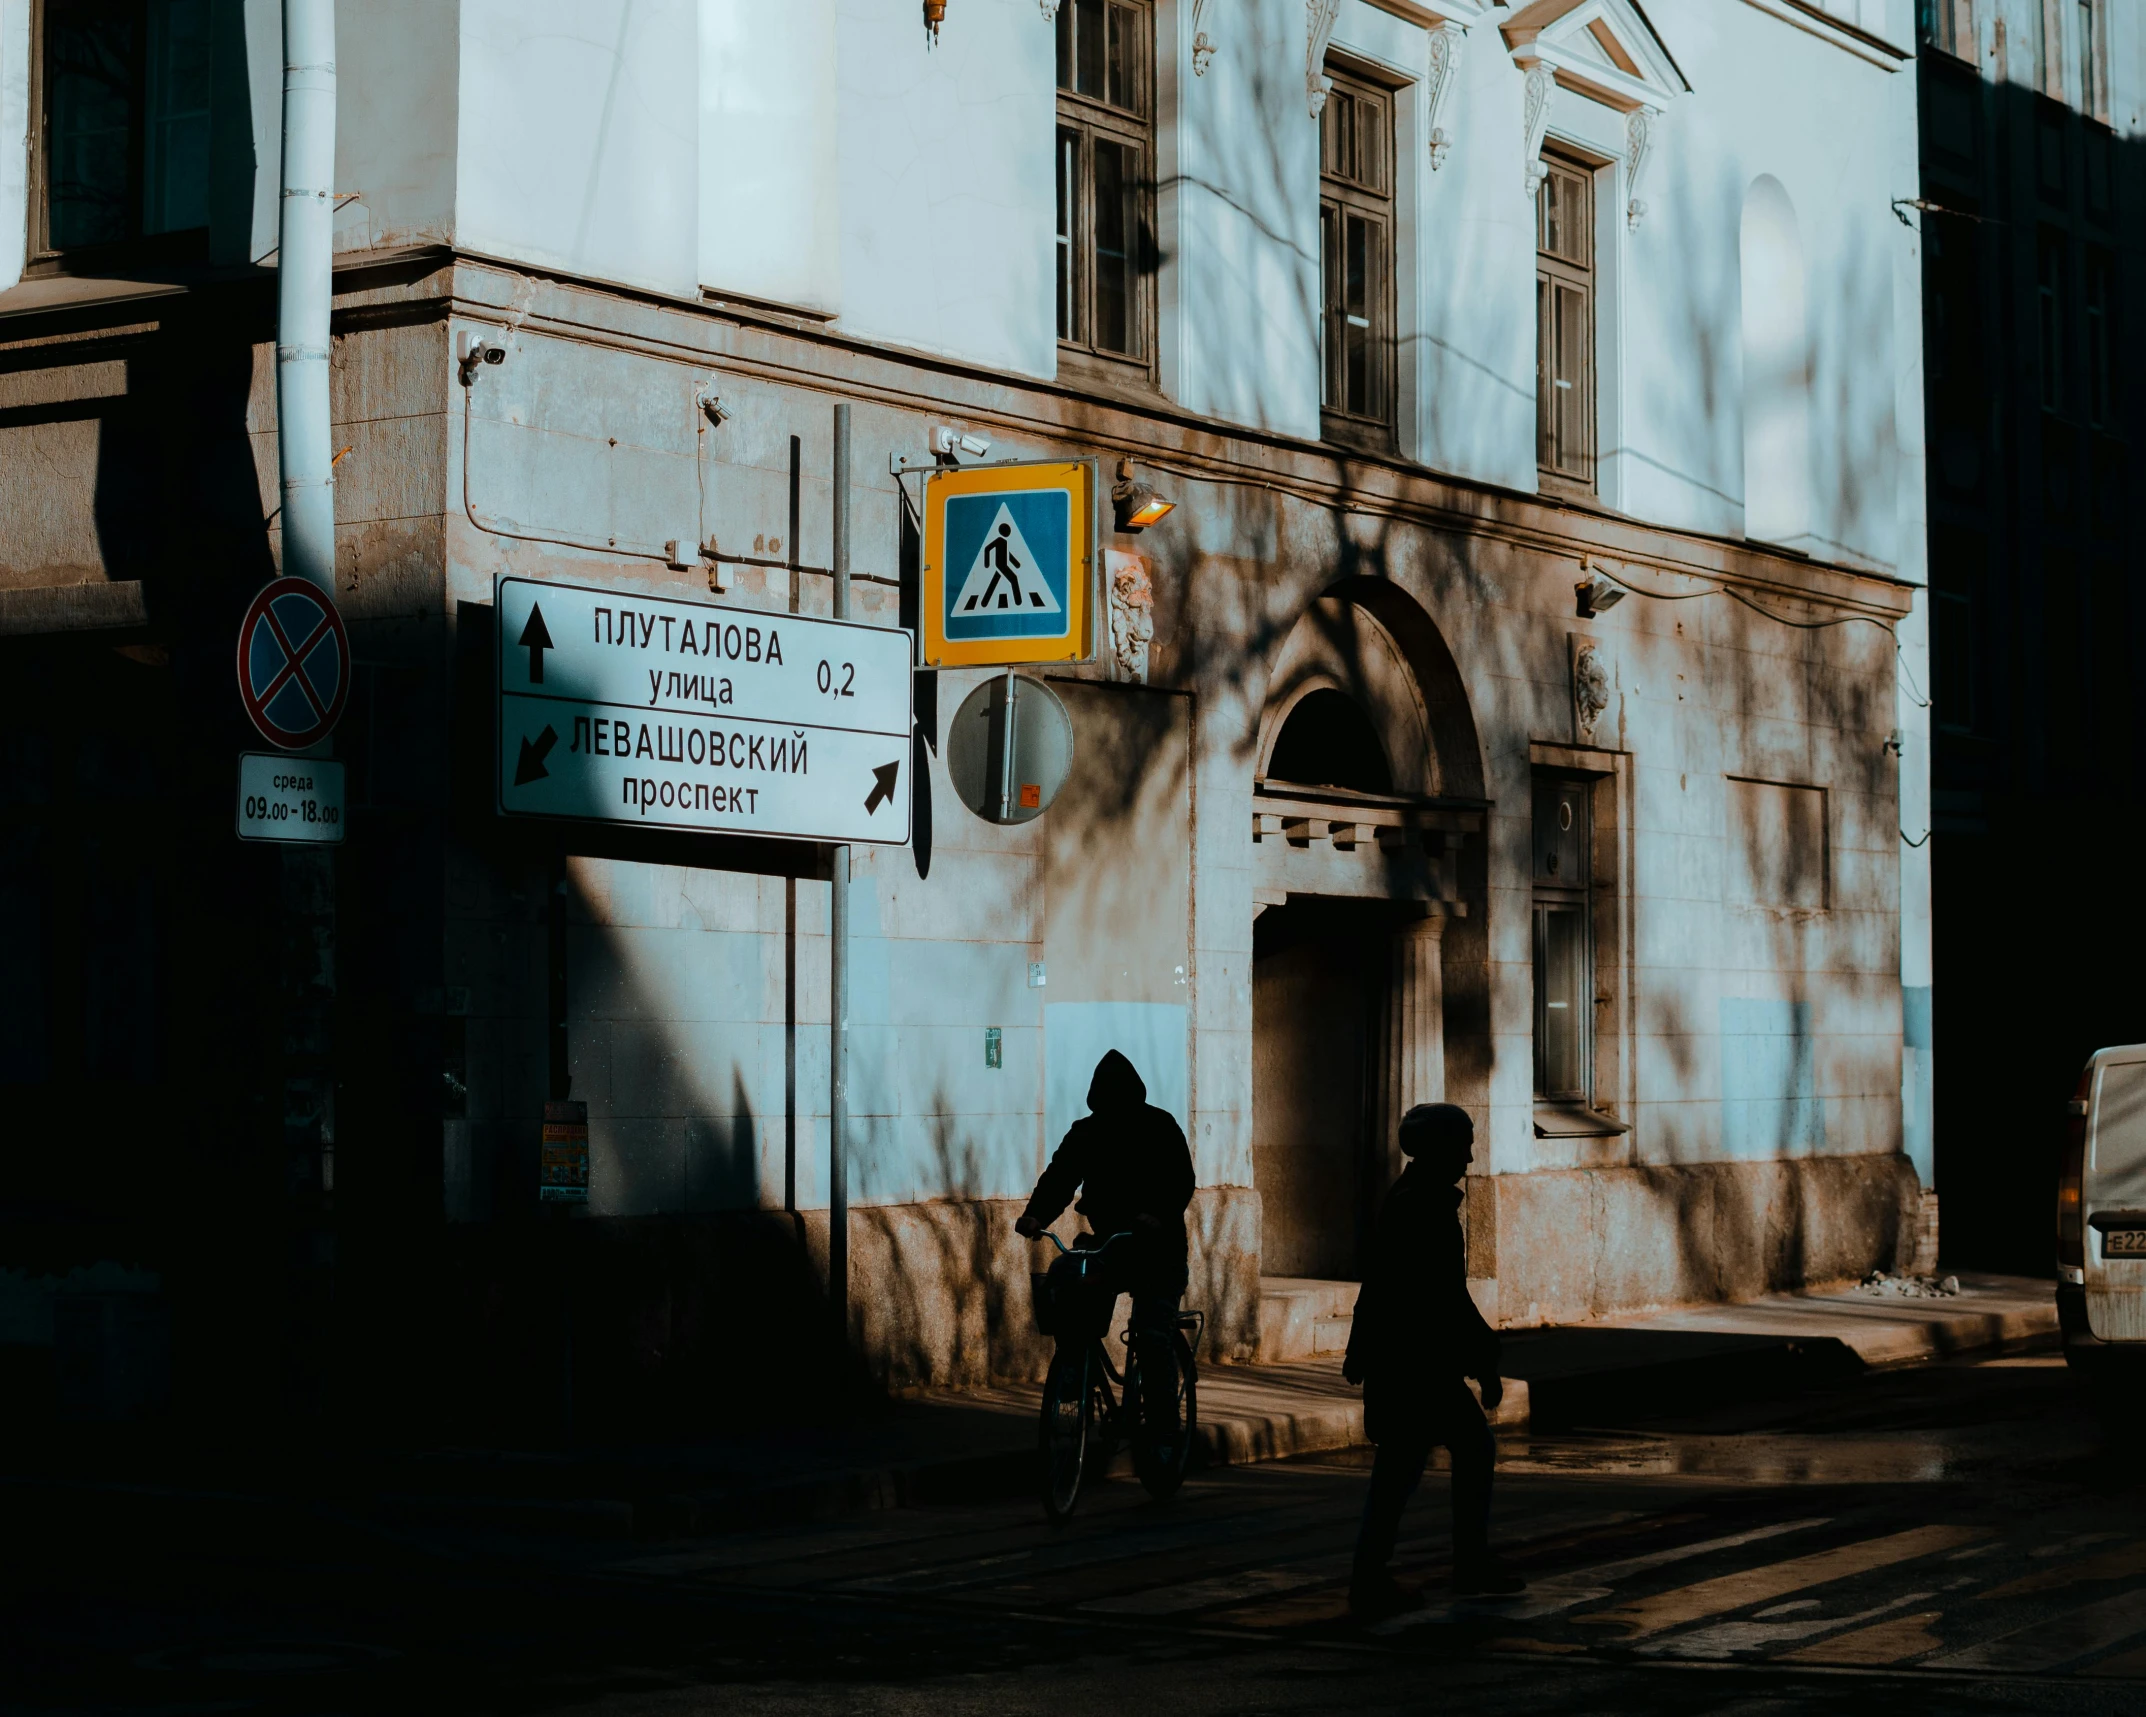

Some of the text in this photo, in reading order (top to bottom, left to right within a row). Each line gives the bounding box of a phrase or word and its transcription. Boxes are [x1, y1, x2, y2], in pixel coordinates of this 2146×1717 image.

[594, 606, 784, 666] ПЛУТАЛОВА
[649, 668, 734, 708] улица
[816, 659, 855, 701] 0,2
[569, 716, 809, 775] ЛЕВАШОВСКИЙ
[273, 775, 314, 793] среда
[622, 776, 760, 816] проспект
